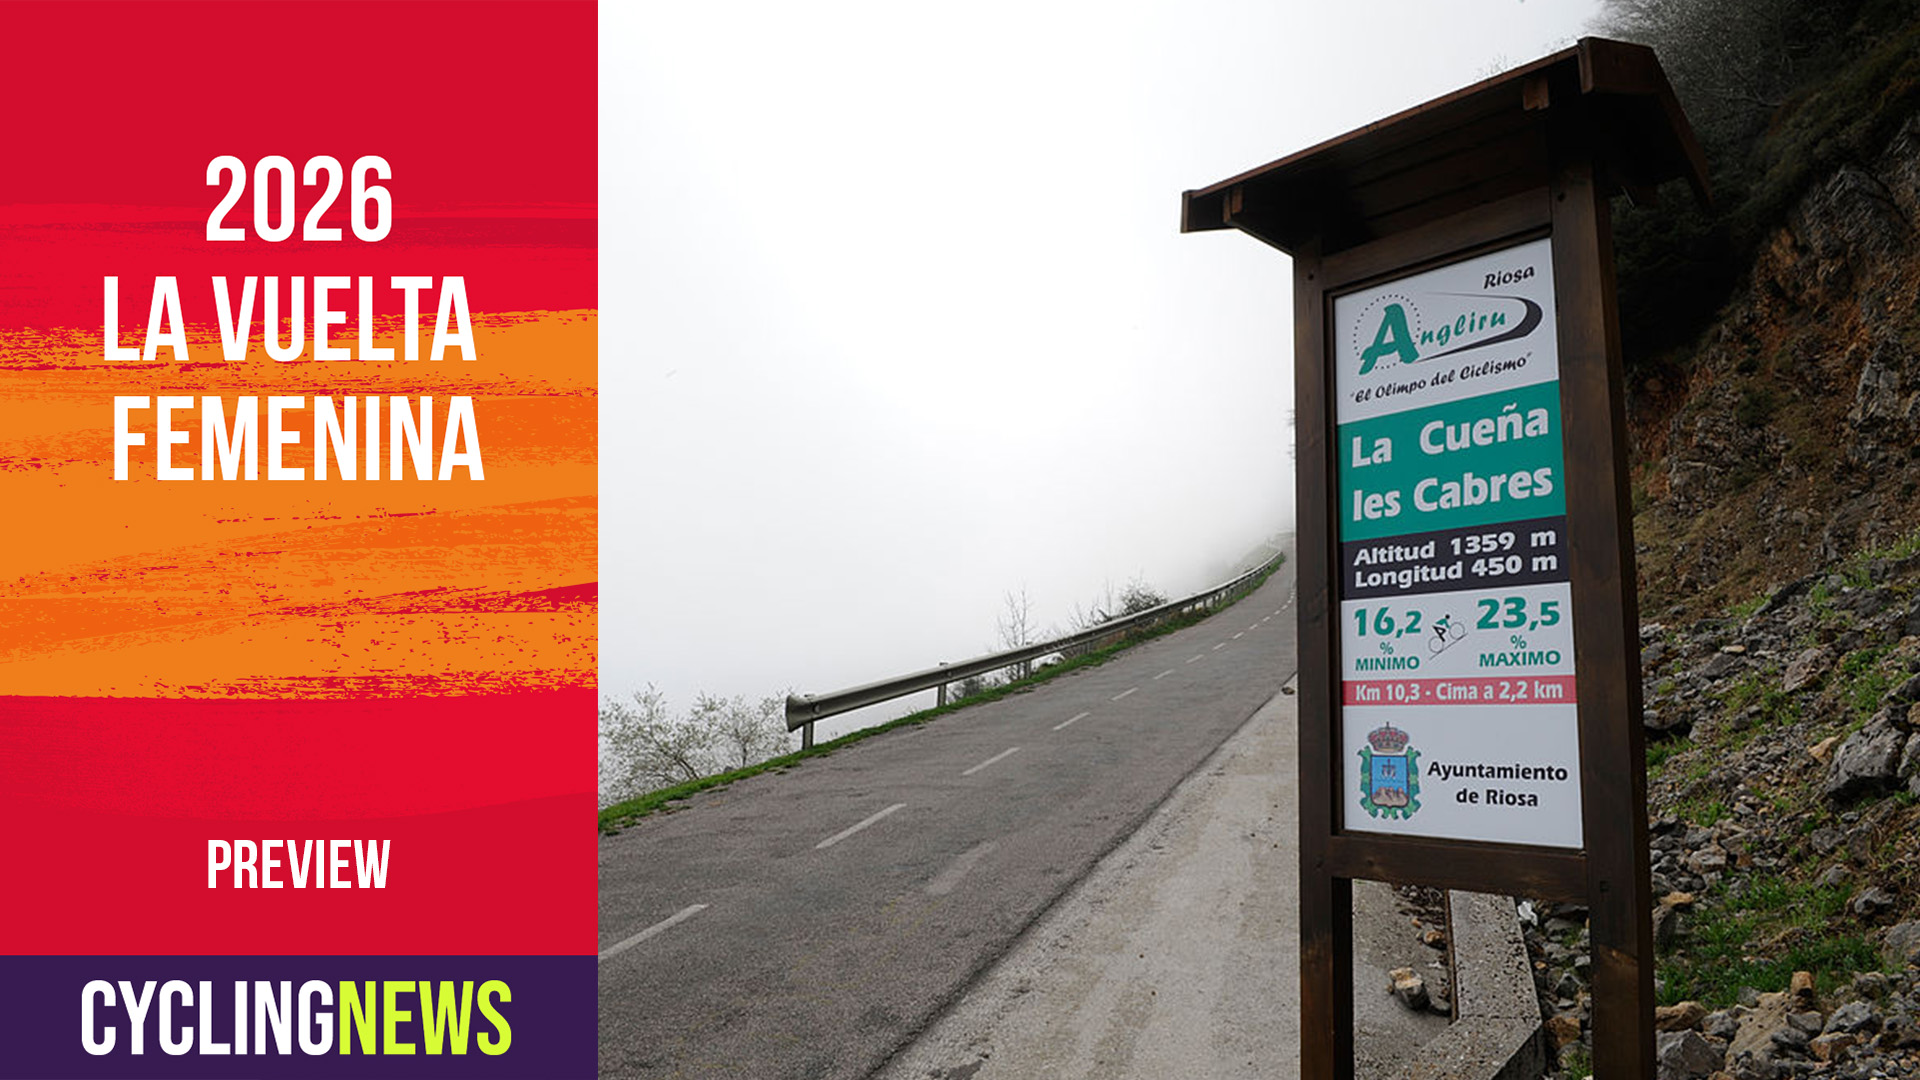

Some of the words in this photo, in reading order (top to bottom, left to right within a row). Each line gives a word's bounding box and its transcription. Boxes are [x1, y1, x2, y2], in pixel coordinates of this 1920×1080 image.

[1483, 266, 1535, 289] Riosa
[1358, 303, 1506, 376] Angliru
[1375, 379, 1426, 399] Olimpo
[1431, 371, 1455, 386] del
[1351, 436, 1392, 468] La
[1419, 403, 1549, 455] Cueña
[1353, 489, 1401, 521] les
[1413, 467, 1554, 512] Cabres
[1353, 541, 1435, 566] Altitud
[1450, 532, 1515, 556] 1359
[1530, 530, 1557, 547] m
[1355, 561, 1463, 588] Longitud
[1471, 555, 1523, 577] 450
[1532, 554, 1558, 571] m
[1354, 607, 1422, 638] 16,2
[1476, 597, 1561, 631] 23,5
[1379, 641, 1395, 655] %
[1510, 634, 1528, 650] %
[1355, 656, 1420, 671] MINIMO
[1479, 650, 1561, 668] MAXIMO
[1356, 685, 1381, 701] Km
[1386, 680, 1420, 703] 10,3
[1436, 682, 1479, 700] Cima
[1483, 684, 1493, 700] a
[1500, 682, 1529, 702] 2,2
[1534, 680, 1564, 699] km
[1427, 761, 1569, 782] Ayuntamiento
[1456, 788, 1480, 804] de
[1486, 789, 1539, 807] Riosa
